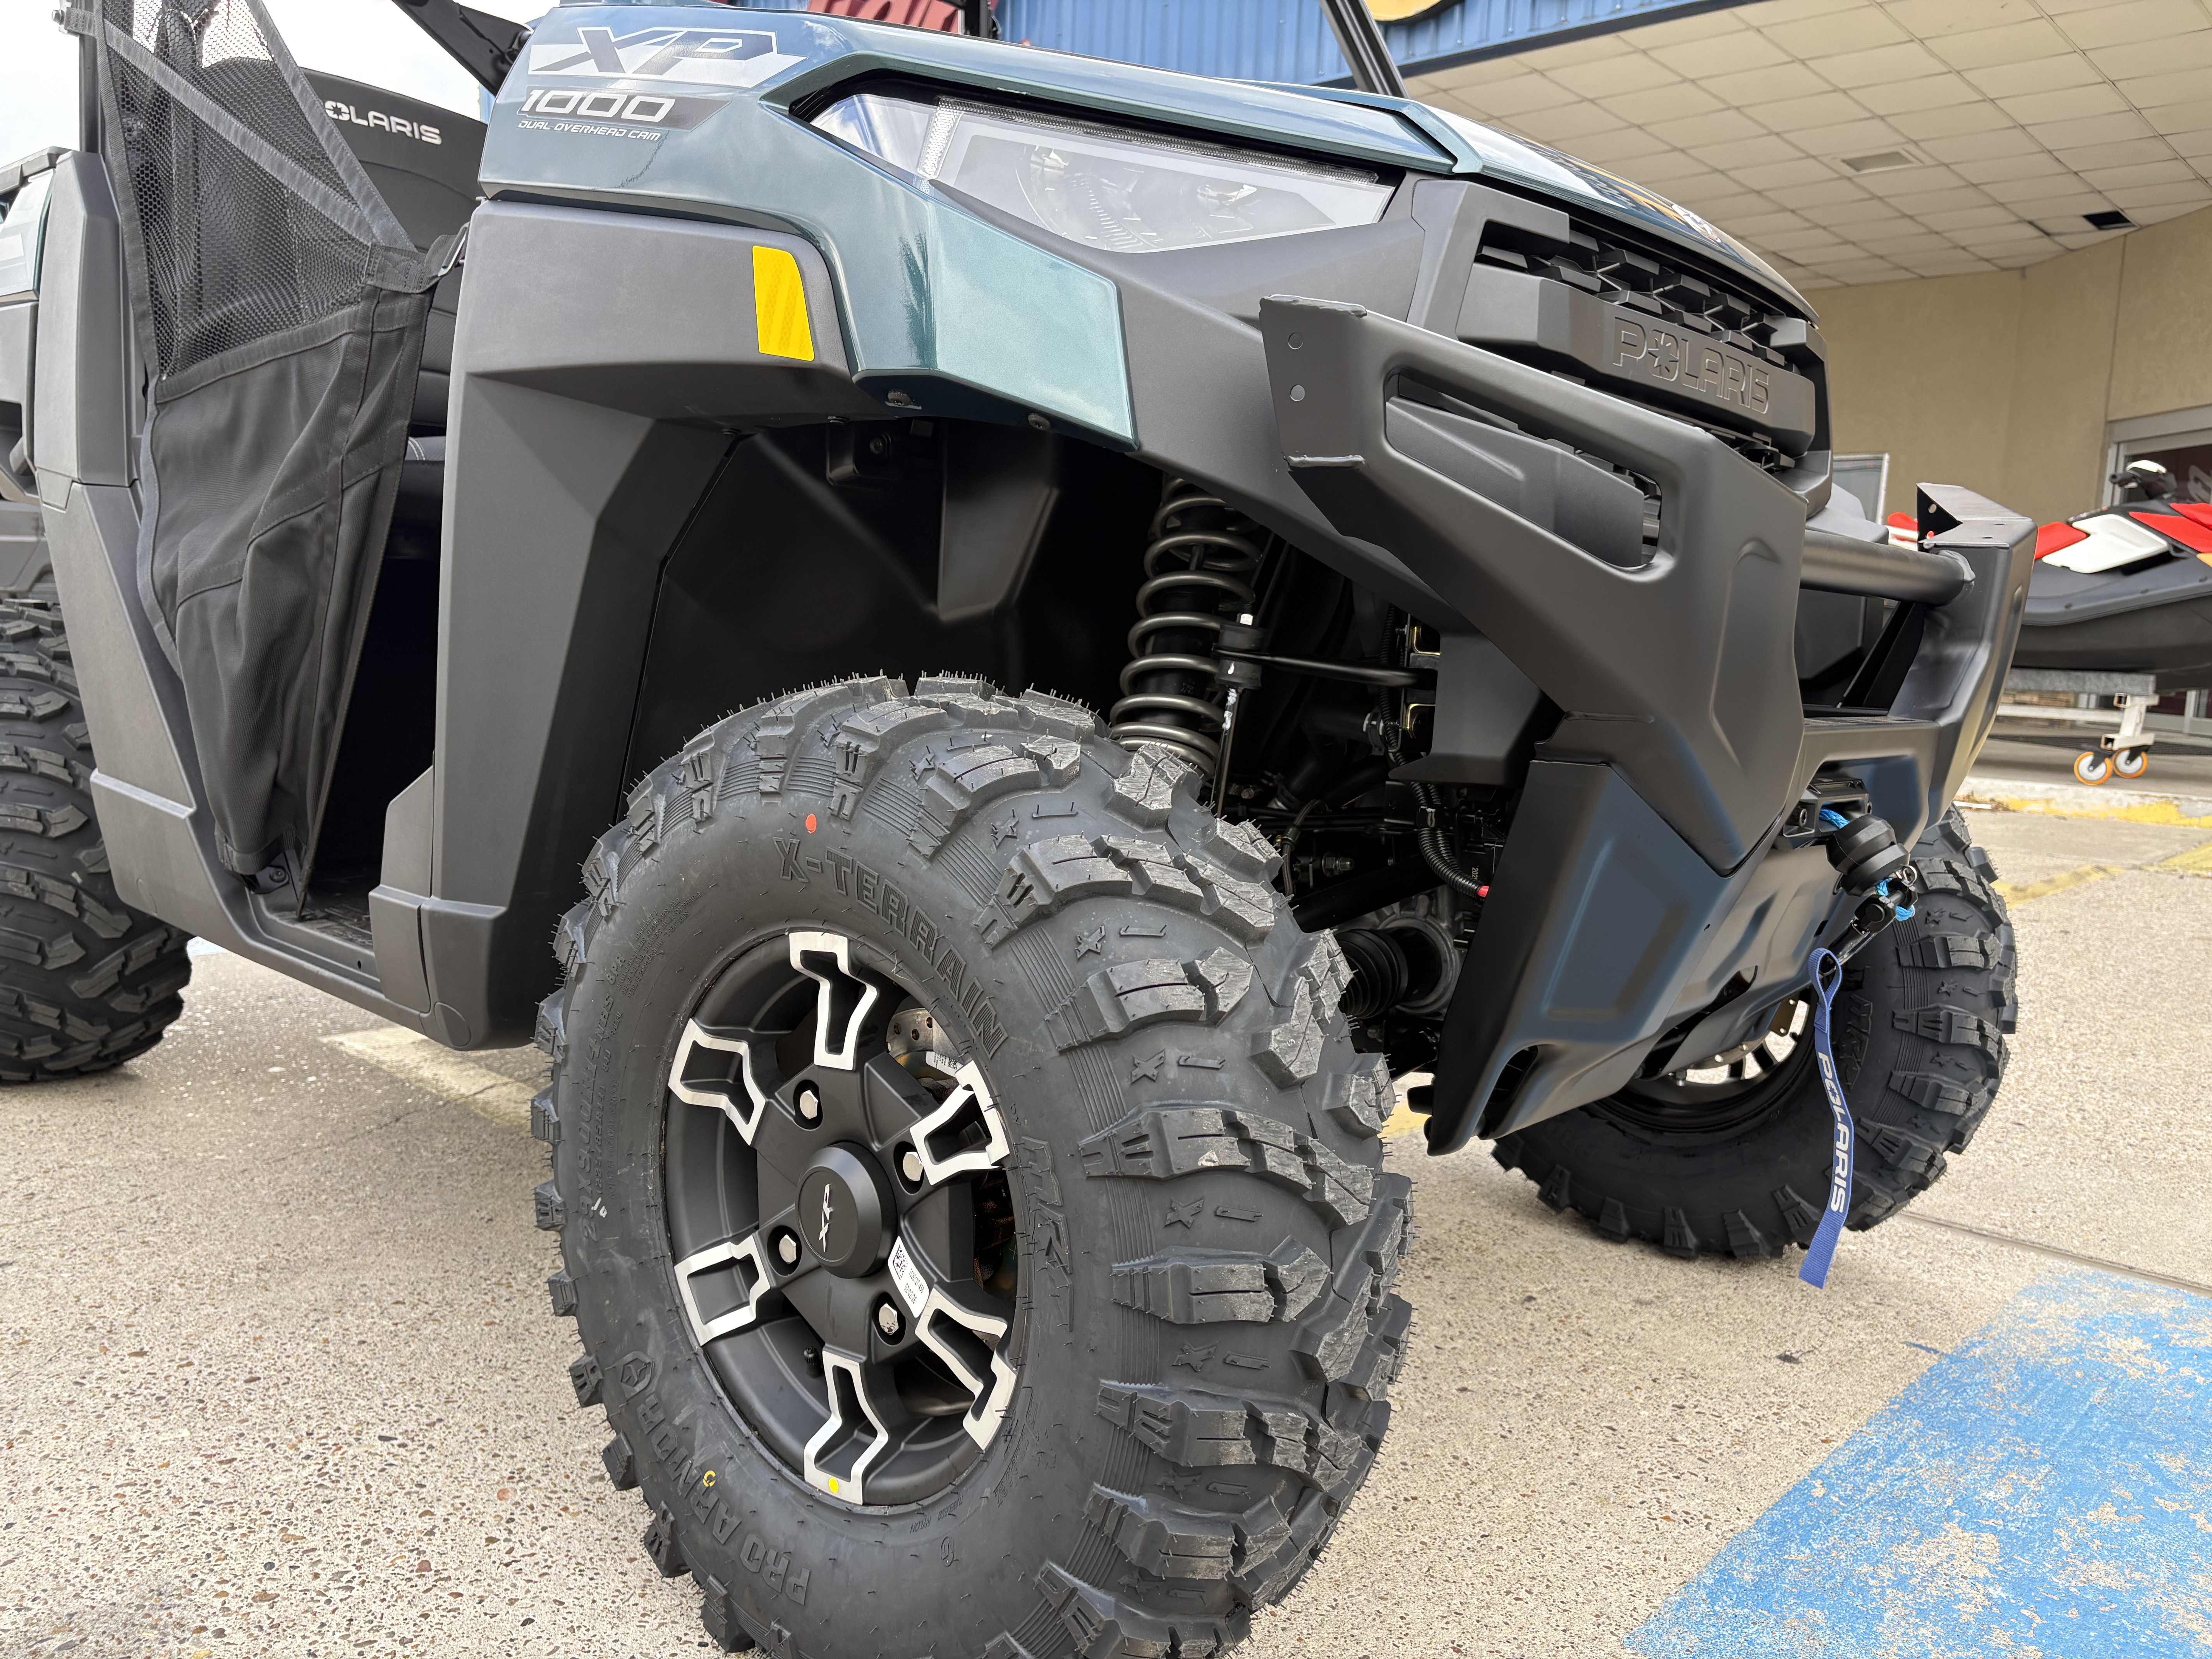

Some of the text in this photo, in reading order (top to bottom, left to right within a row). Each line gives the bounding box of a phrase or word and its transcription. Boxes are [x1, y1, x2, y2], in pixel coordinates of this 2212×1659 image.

[531, 27, 777, 75] XP
[325, 100, 442, 145] OLARIS
[521, 89, 675, 122] 1000
[518, 120, 661, 141] DUAL OVERHEAD CAM
[1613, 316, 1769, 414] POLARIS
[606, 953, 626, 985] 8PR
[773, 836, 1008, 1059] X-TERRAIN
[611, 1011, 623, 1037] RADIAL
[1818, 1052, 1849, 1214] POLARIS
[637, 1395, 811, 1606] PRO ARMOR
[910, 1517, 931, 1534] NYLON
